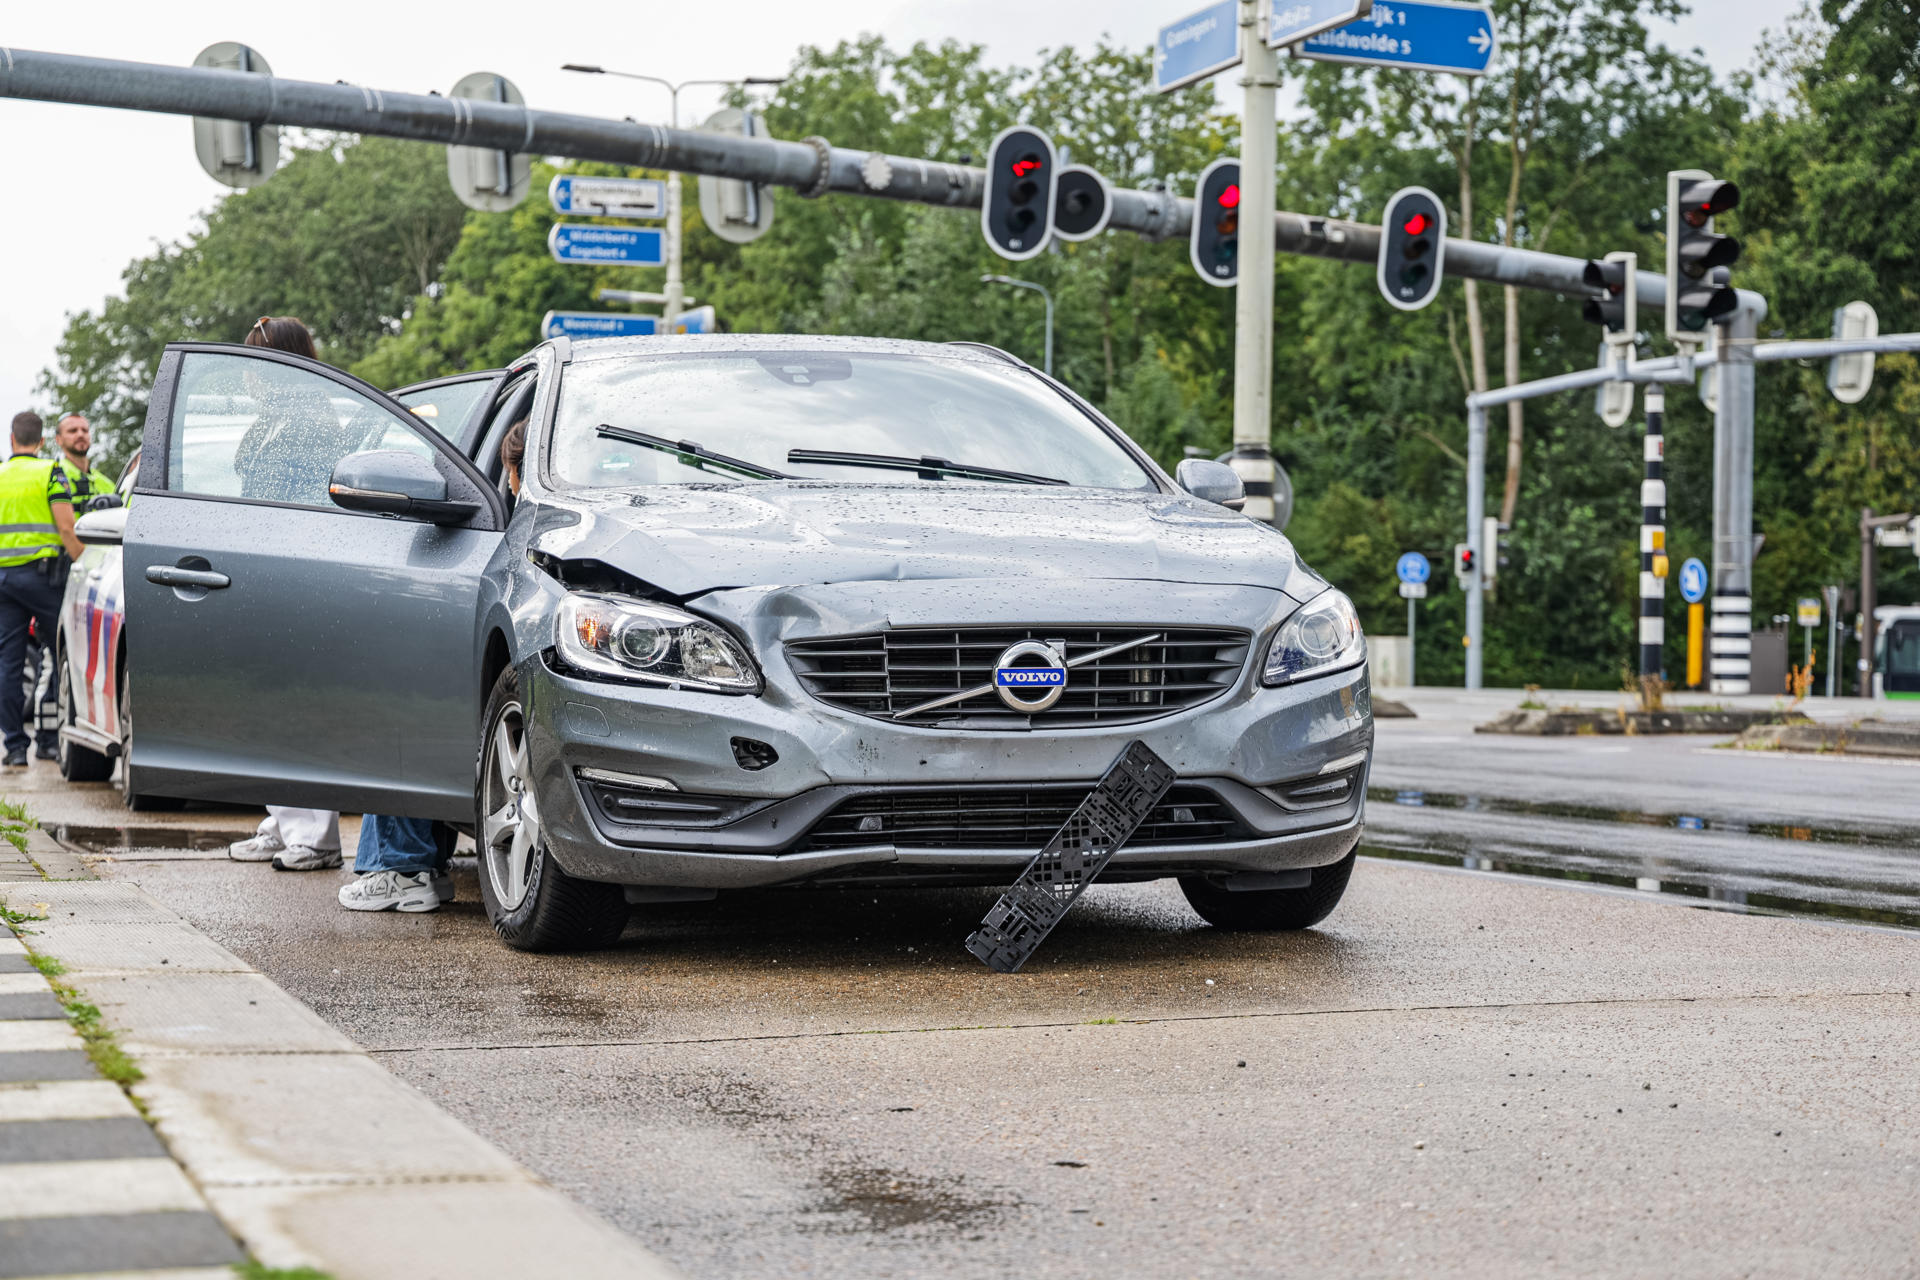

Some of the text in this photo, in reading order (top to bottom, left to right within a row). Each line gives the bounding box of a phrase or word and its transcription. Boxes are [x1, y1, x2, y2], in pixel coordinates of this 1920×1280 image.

[1397, 11, 1406, 26] 1
[1401, 39, 1412, 55] 5
[1001, 672, 1061, 682] VOLVO
